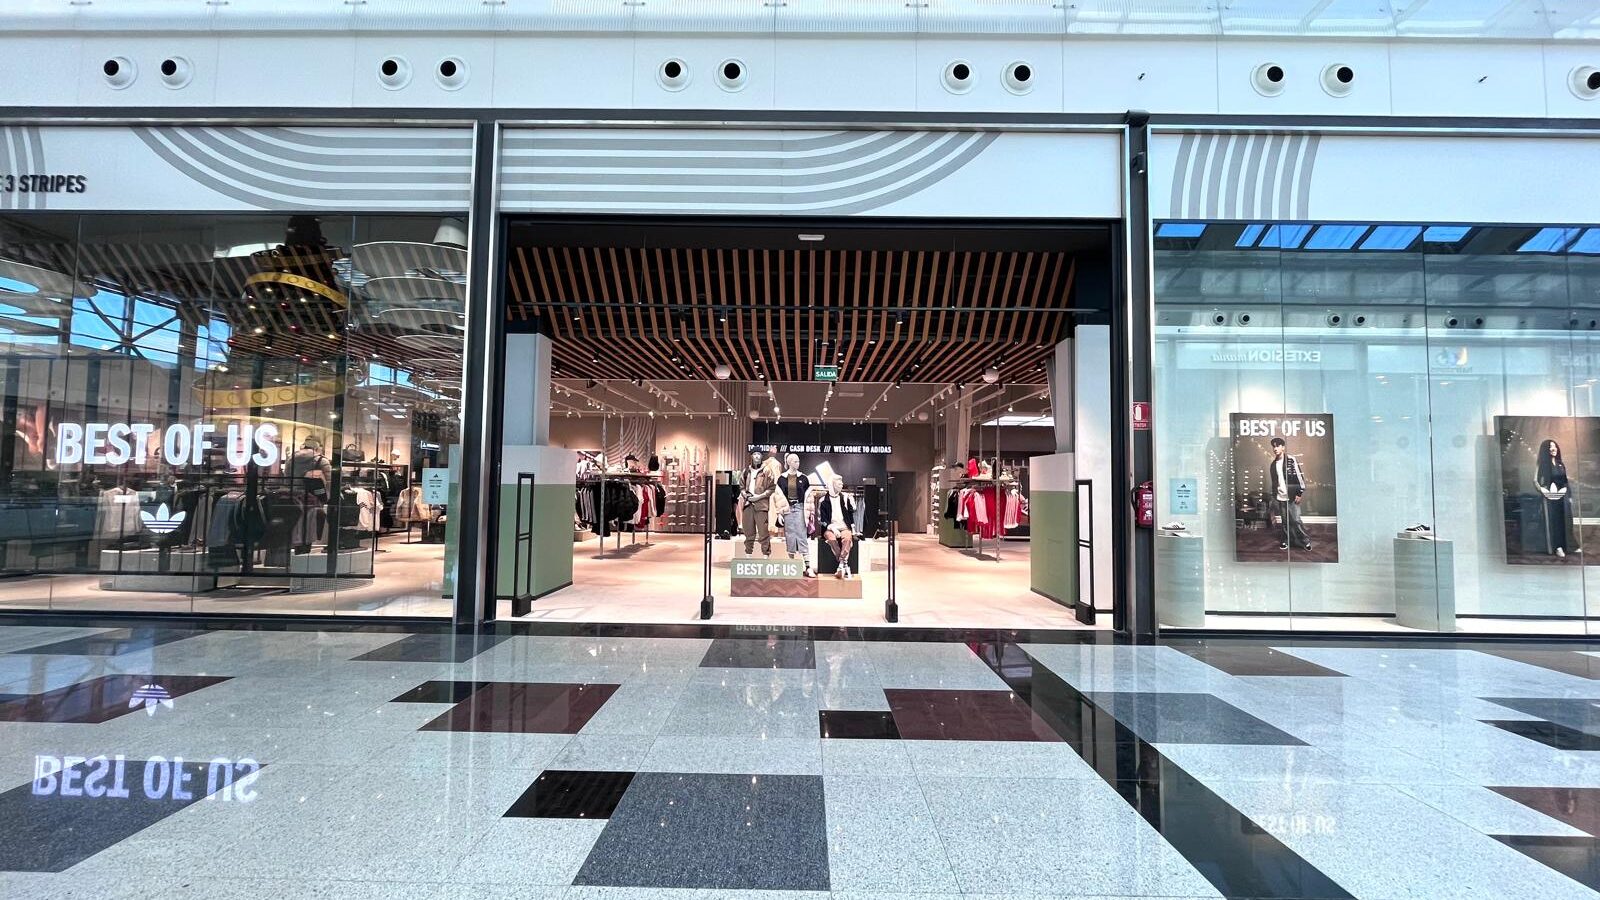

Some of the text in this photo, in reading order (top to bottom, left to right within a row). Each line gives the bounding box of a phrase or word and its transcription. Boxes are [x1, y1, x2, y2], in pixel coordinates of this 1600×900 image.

[5, 174, 15, 193] 3
[19, 174, 87, 194] STRIPES
[815, 370, 837, 378] SALIDA
[1240, 419, 1326, 437] BEST OF US
[56, 423, 279, 467] BEST OF US
[789, 445, 805, 453] CASH
[806, 445, 821, 453] DESK
[833, 445, 861, 453] WELCOME
[870, 446, 892, 454] ADIDAS
[736, 563, 798, 576] BEST OF US
